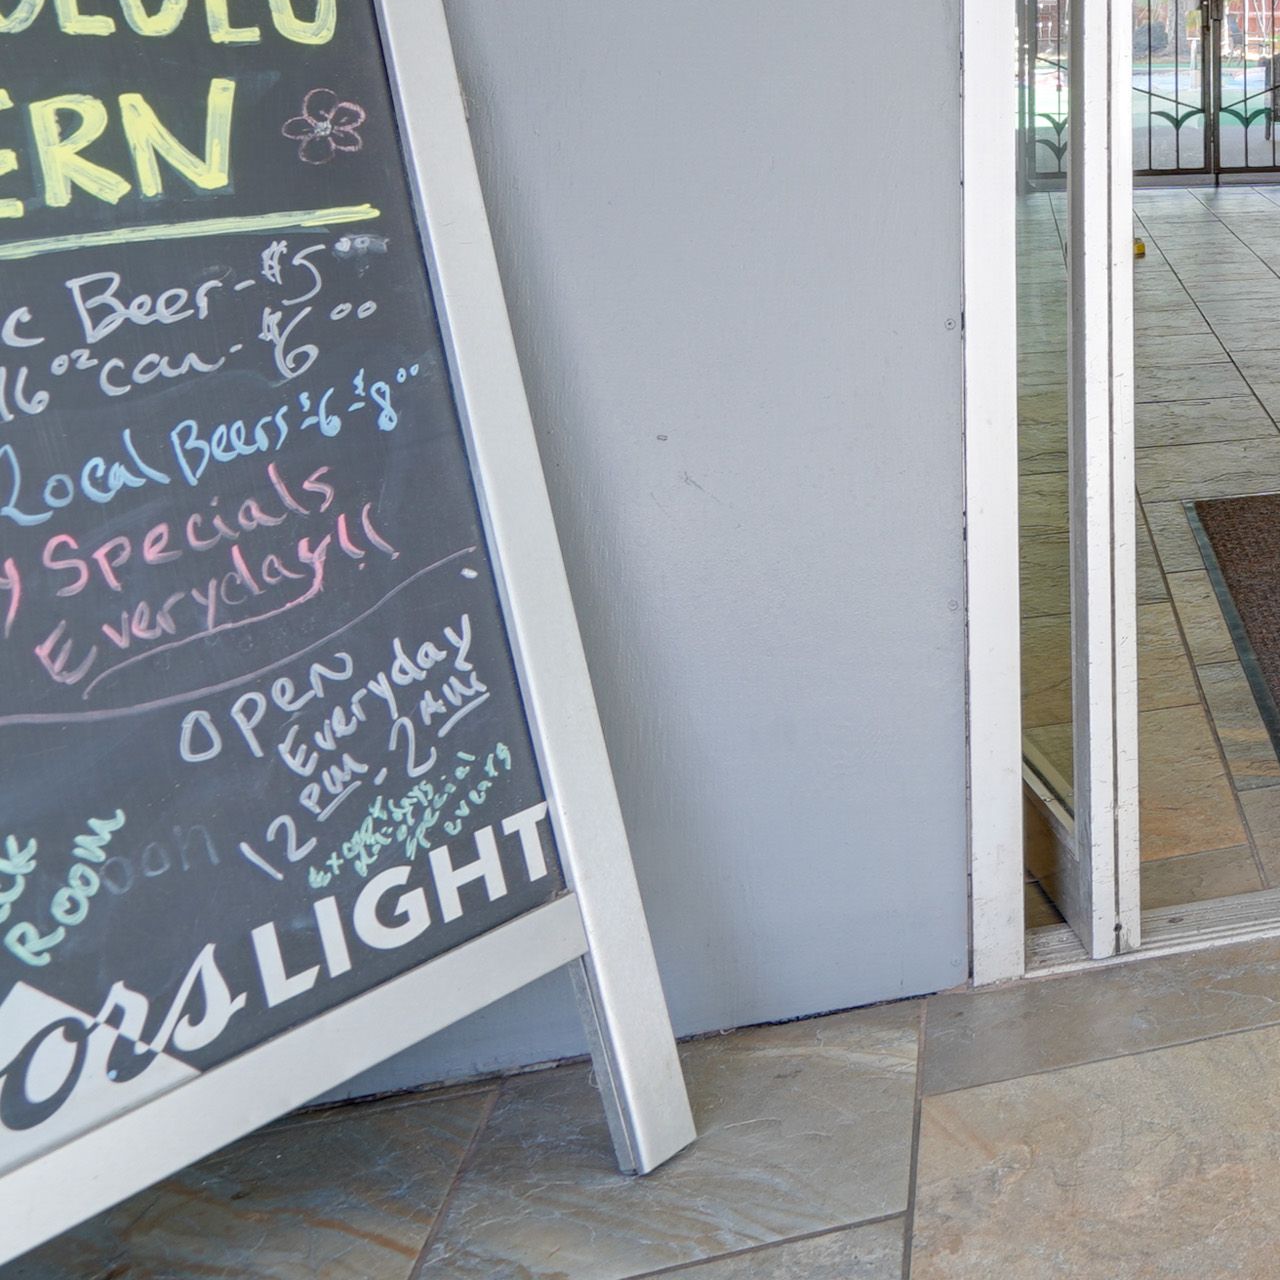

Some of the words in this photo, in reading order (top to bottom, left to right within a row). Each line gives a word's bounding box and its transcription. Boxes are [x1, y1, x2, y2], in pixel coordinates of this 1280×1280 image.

[66, 272, 223, 344] Beer
[0, 428, 171, 526] Local
[170, 405, 288, 486] Beers
[43, 463, 334, 596] Specials
[278, 614, 472, 777] Everyday
[251, 801, 548, 1008] LIGHT
